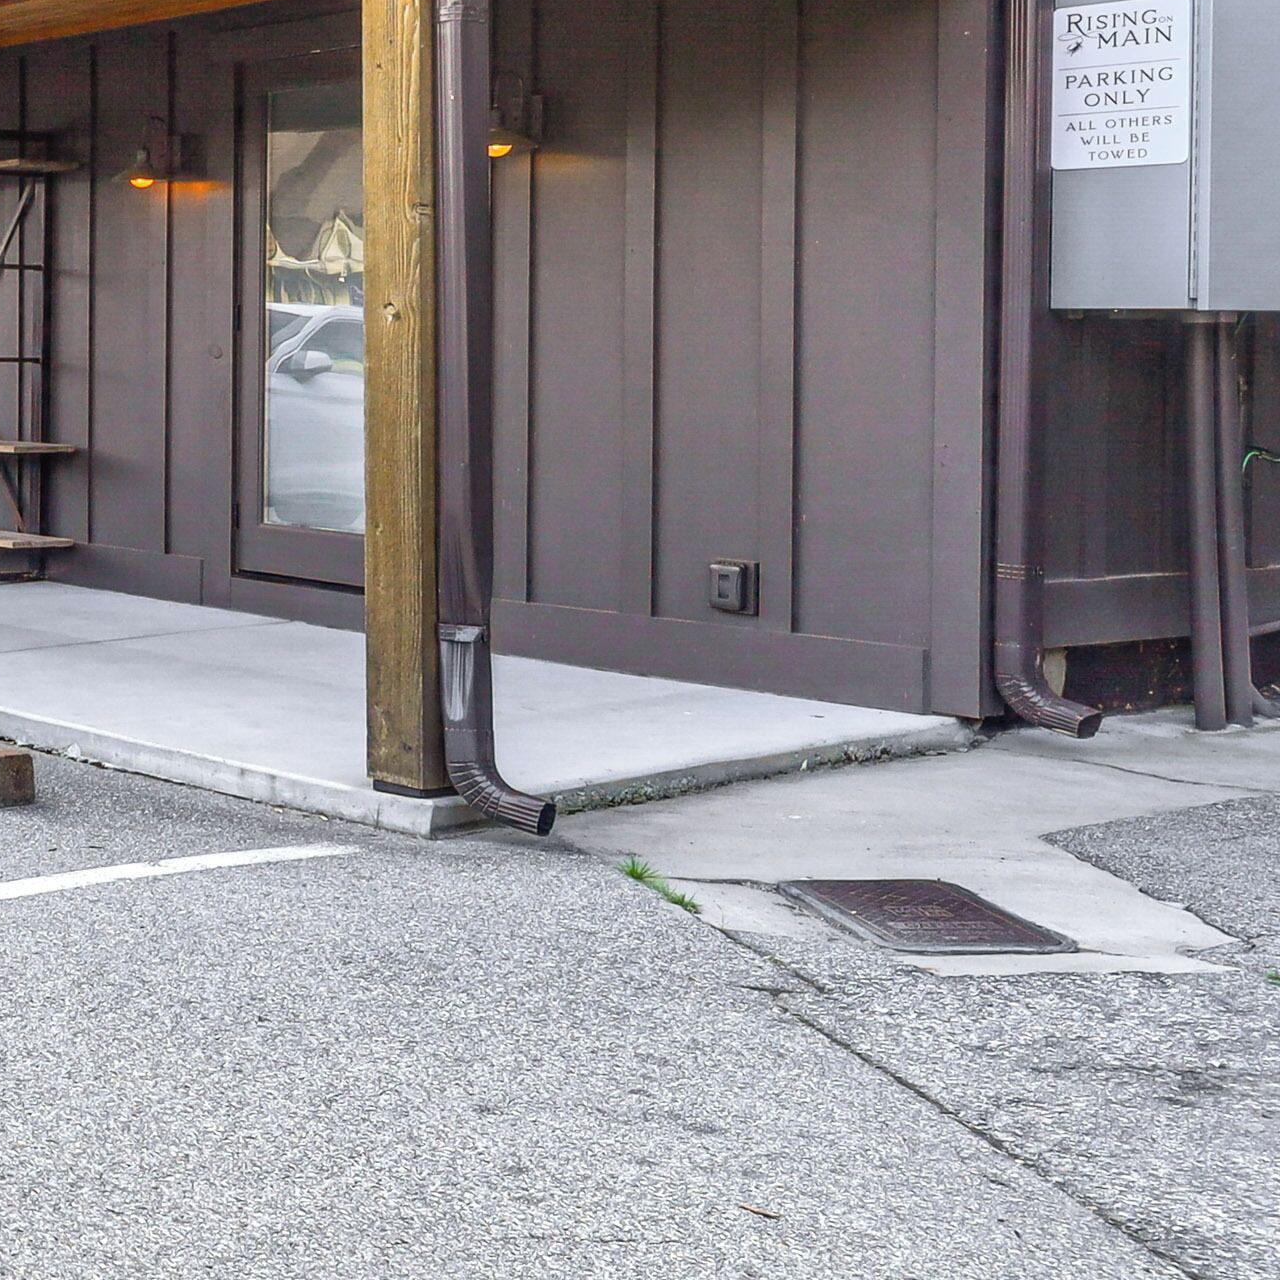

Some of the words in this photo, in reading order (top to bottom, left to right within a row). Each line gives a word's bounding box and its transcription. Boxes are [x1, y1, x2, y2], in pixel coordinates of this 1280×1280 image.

[1066, 9, 1158, 36] RISING
[1158, 15, 1173, 24] ON
[1097, 25, 1173, 50] MAIN
[1065, 66, 1173, 90] PARKING
[1084, 88, 1151, 107] ONLY
[1065, 120, 1097, 132] ALL
[1104, 115, 1173, 129] OTHERS
[1080, 135, 1121, 146] WILL
[1130, 131, 1150, 143] BE
[1088, 148, 1148, 161] TOWED
